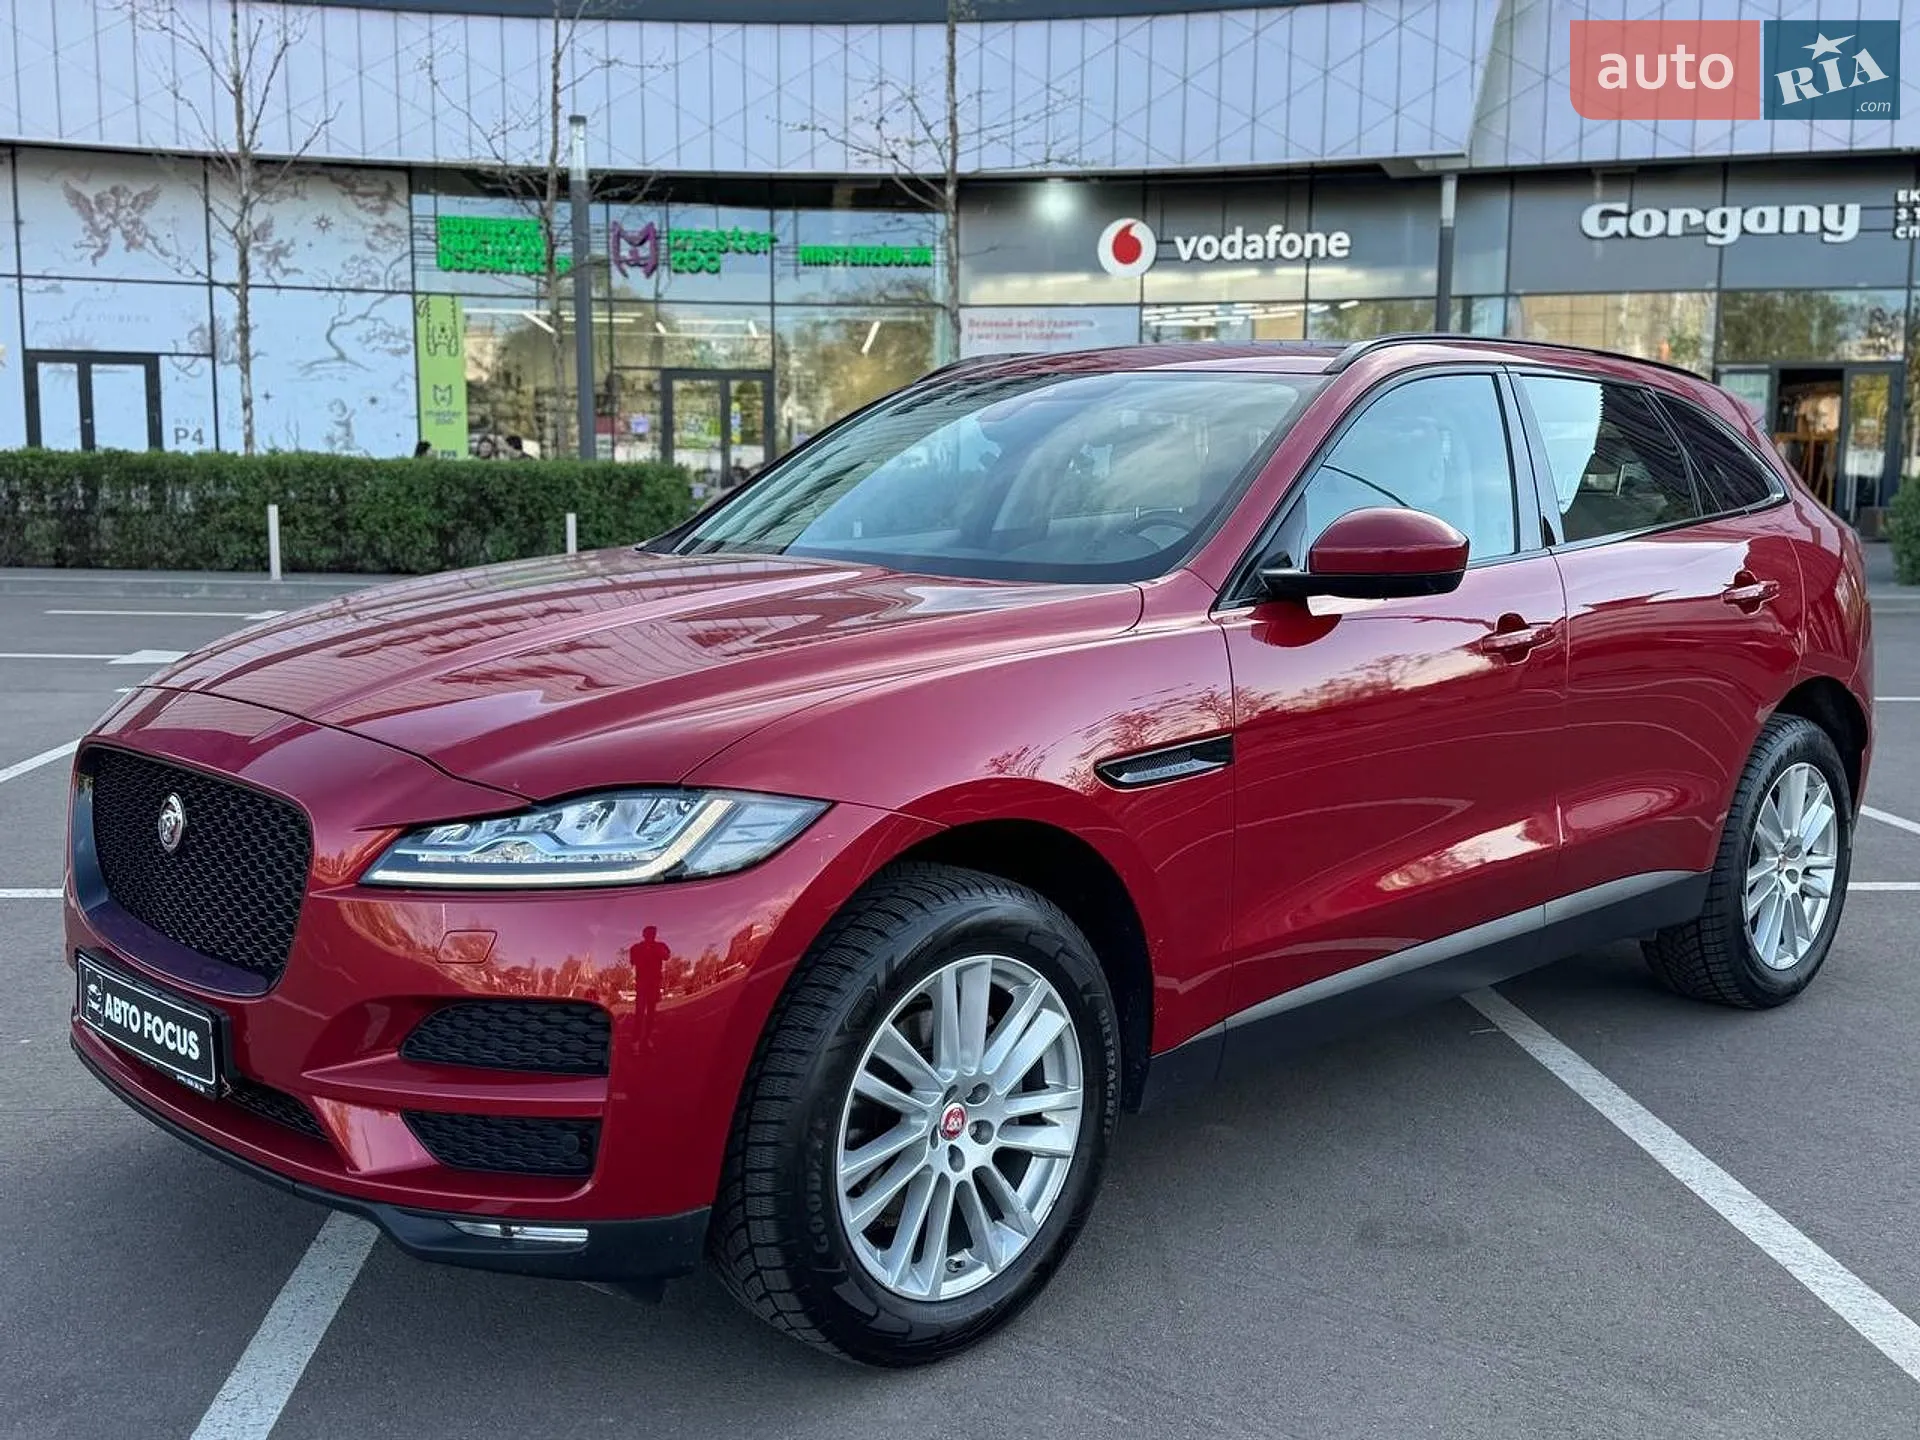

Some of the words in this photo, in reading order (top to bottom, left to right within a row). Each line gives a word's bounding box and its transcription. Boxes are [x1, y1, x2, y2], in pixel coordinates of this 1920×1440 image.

[668, 225, 778, 255] master
[1580, 202, 1861, 246] Gorgany
[1174, 224, 1351, 262] vodafone
[671, 250, 721, 274] zoo
[174, 427, 204, 446] P4
[104, 992, 141, 1034] АВТО
[143, 1010, 200, 1061] FOCUS
